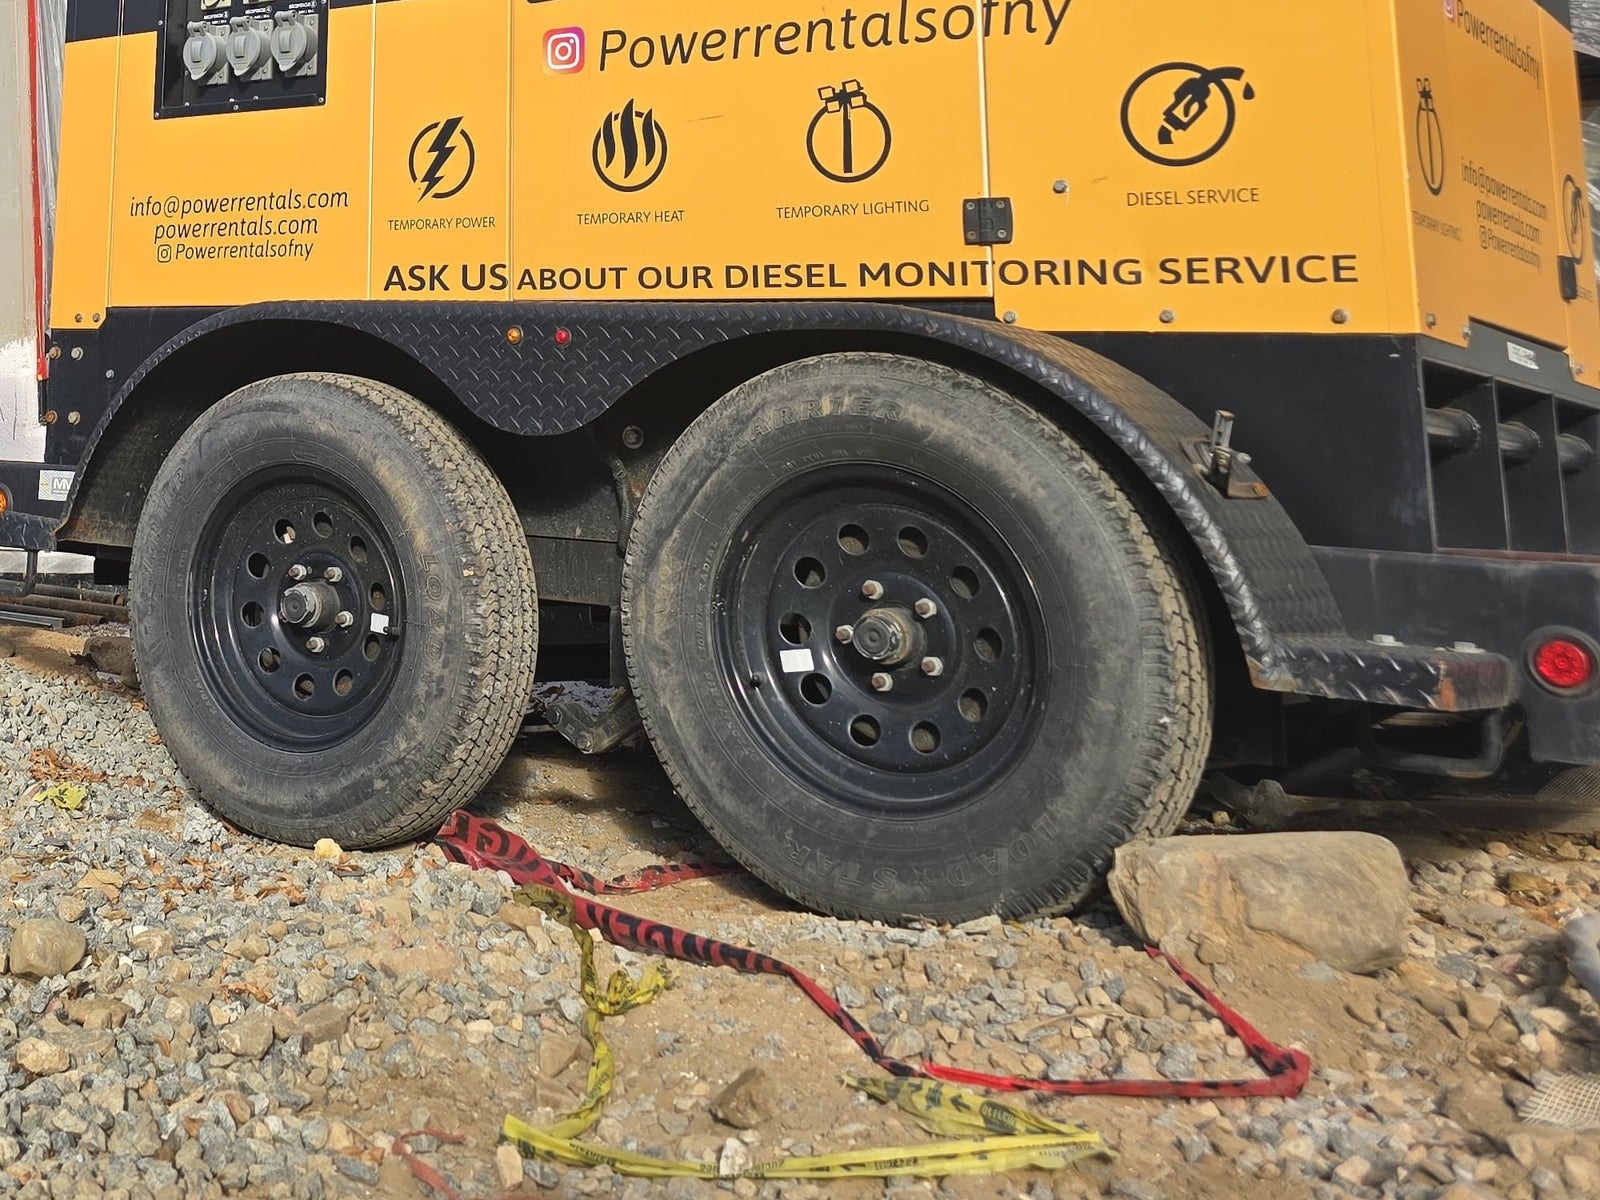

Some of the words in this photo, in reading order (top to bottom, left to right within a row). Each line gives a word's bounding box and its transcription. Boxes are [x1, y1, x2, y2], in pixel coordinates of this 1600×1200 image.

[129, 188, 350, 219] info@powerrentals.com
[1126, 190, 1184, 207] DIESEL
[1186, 187, 1260, 205] SERVICE
[576, 210, 652, 226] TEMPORARY
[654, 209, 686, 224] HEAT
[775, 203, 859, 220] TEMPORARY
[860, 199, 931, 217] LIGHTING
[154, 215, 319, 244] powerrentals.com
[387, 217, 453, 232] TEMPORARY
[454, 216, 497, 230] POWER
[175, 238, 314, 262] Powerrentalsofny
[383, 264, 450, 293] ASK
[460, 263, 510, 292] US
[517, 266, 629, 292] ABOUT
[638, 265, 712, 291] OUR
[725, 262, 848, 289] DIESEL
[858, 257, 1144, 289] MONITORING
[1158, 254, 1360, 286] SERVICE
